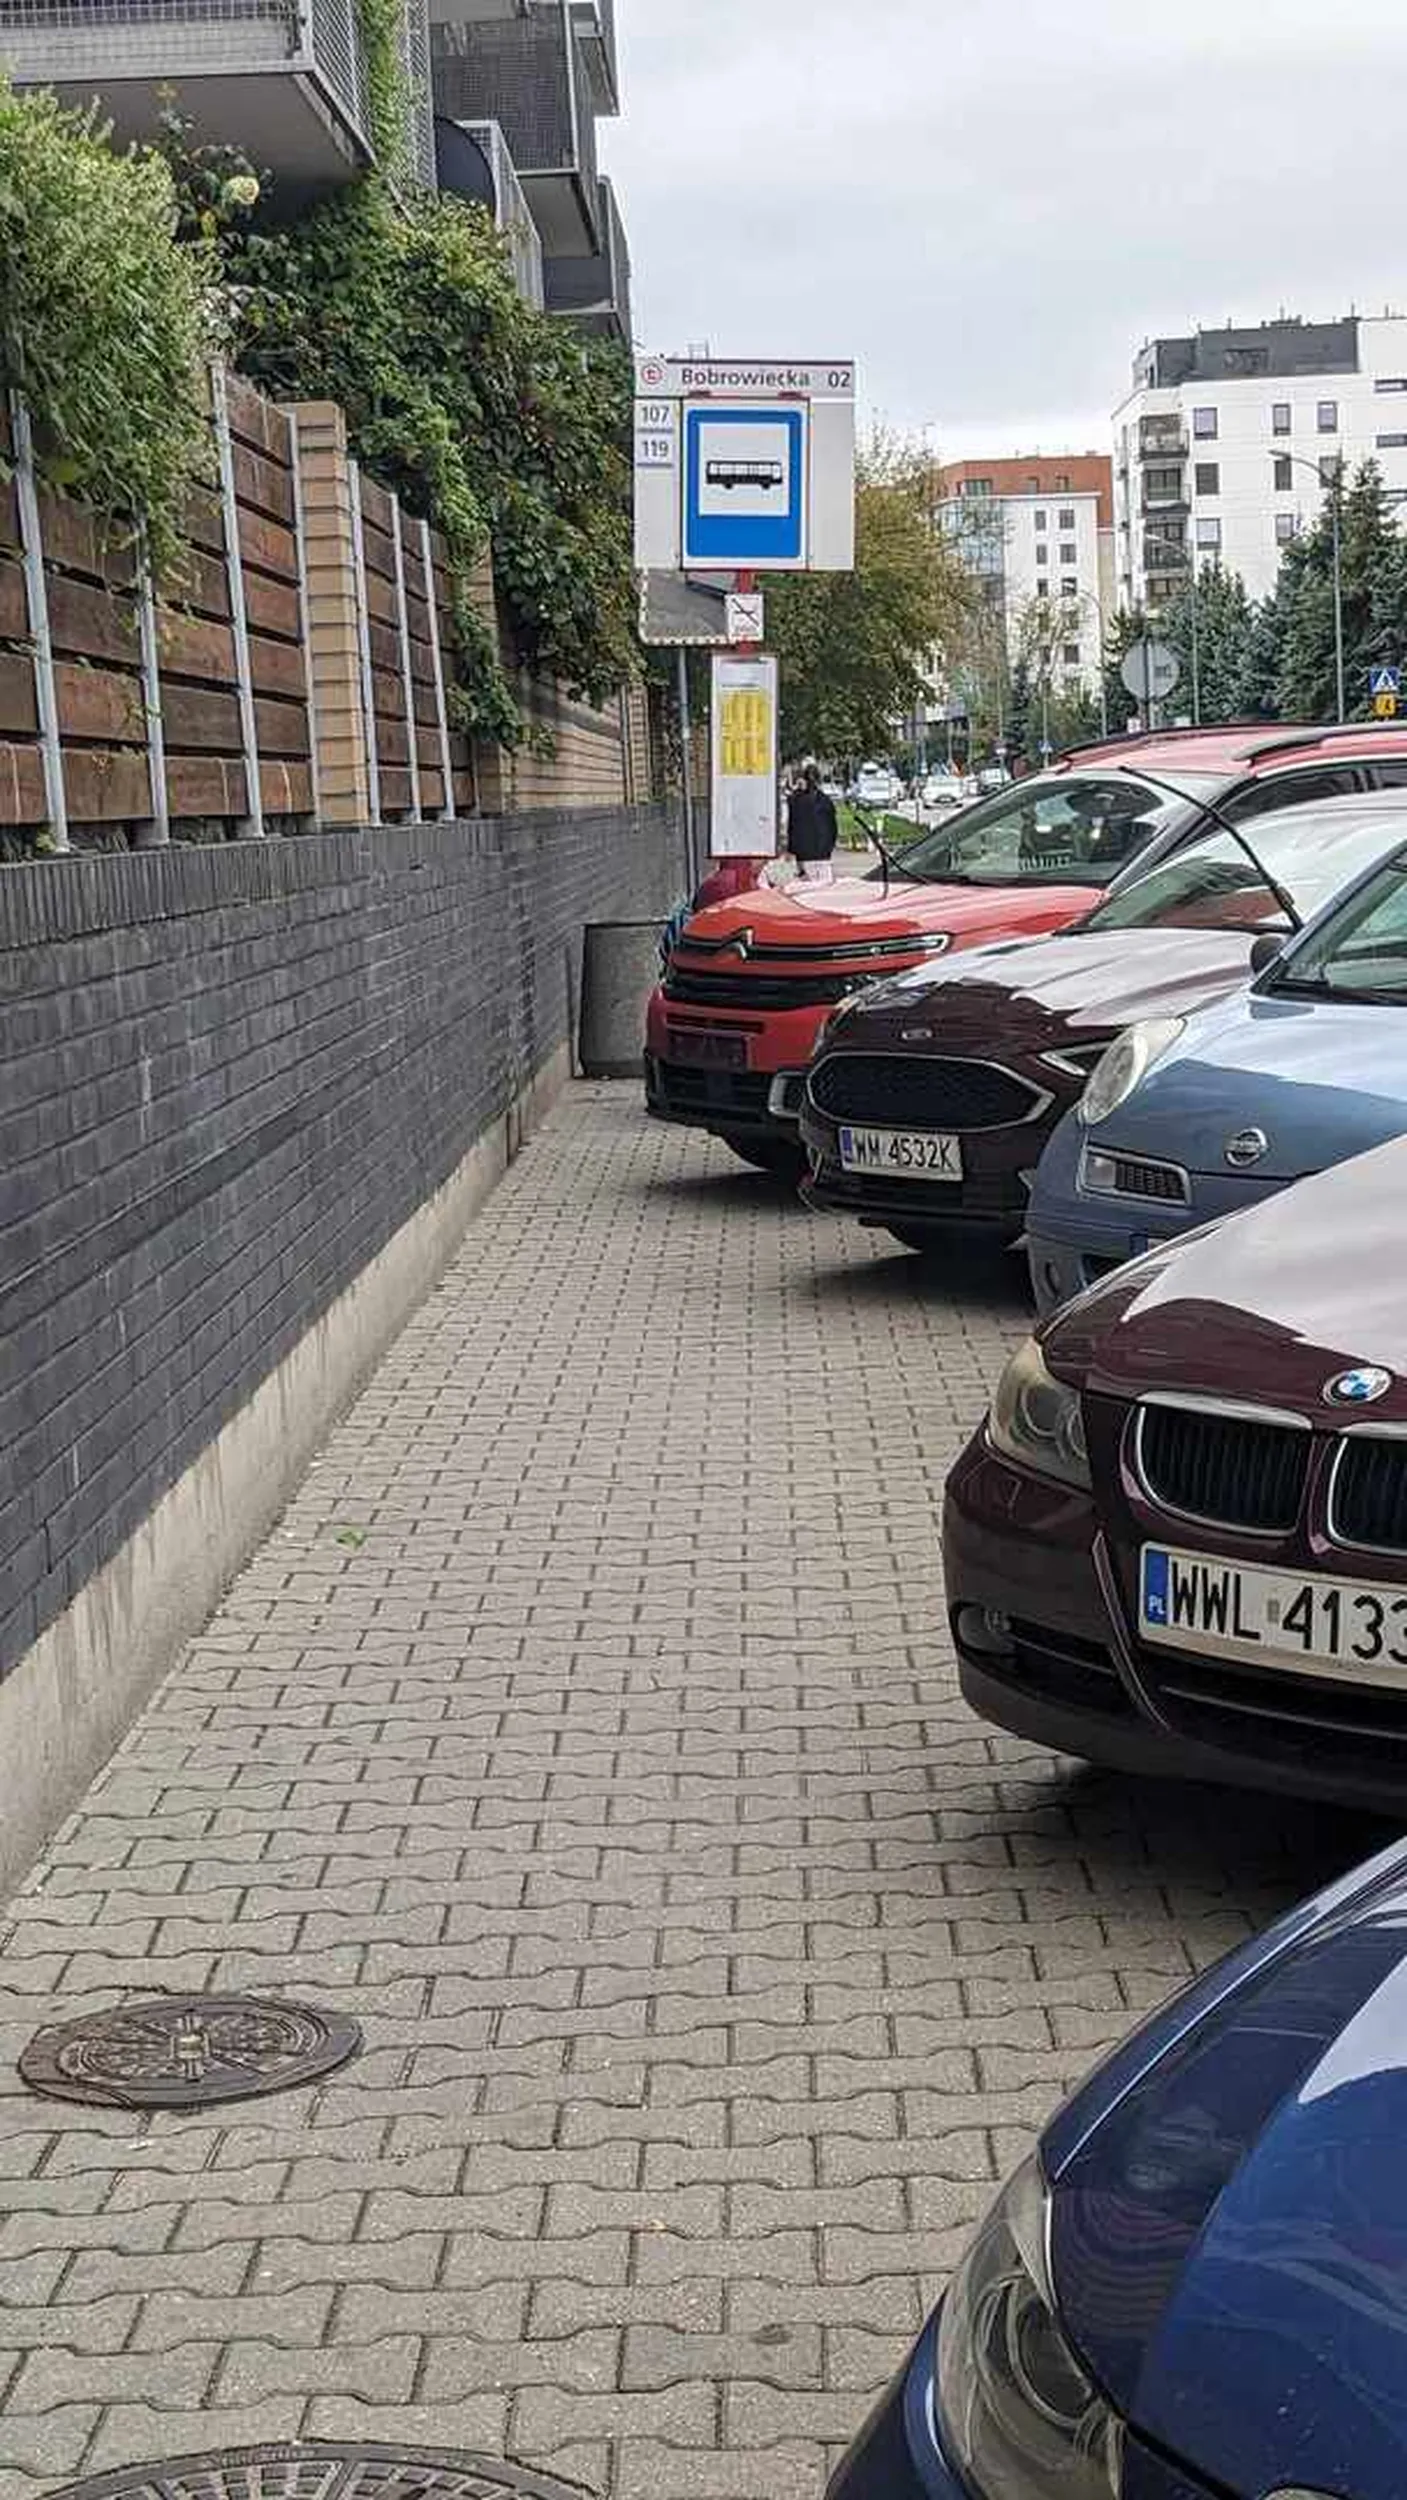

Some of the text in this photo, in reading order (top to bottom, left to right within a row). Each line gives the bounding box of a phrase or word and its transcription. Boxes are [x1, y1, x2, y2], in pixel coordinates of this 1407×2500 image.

[681, 368, 811, 386] Bobrowiecka
[827, 372, 851, 388] 02
[642, 406, 670, 423] 107
[642, 441, 669, 458] 119
[888, 1136, 957, 1172] 4532K
[1148, 1595, 1165, 1615] PL
[1171, 1561, 1261, 1640] WWL
